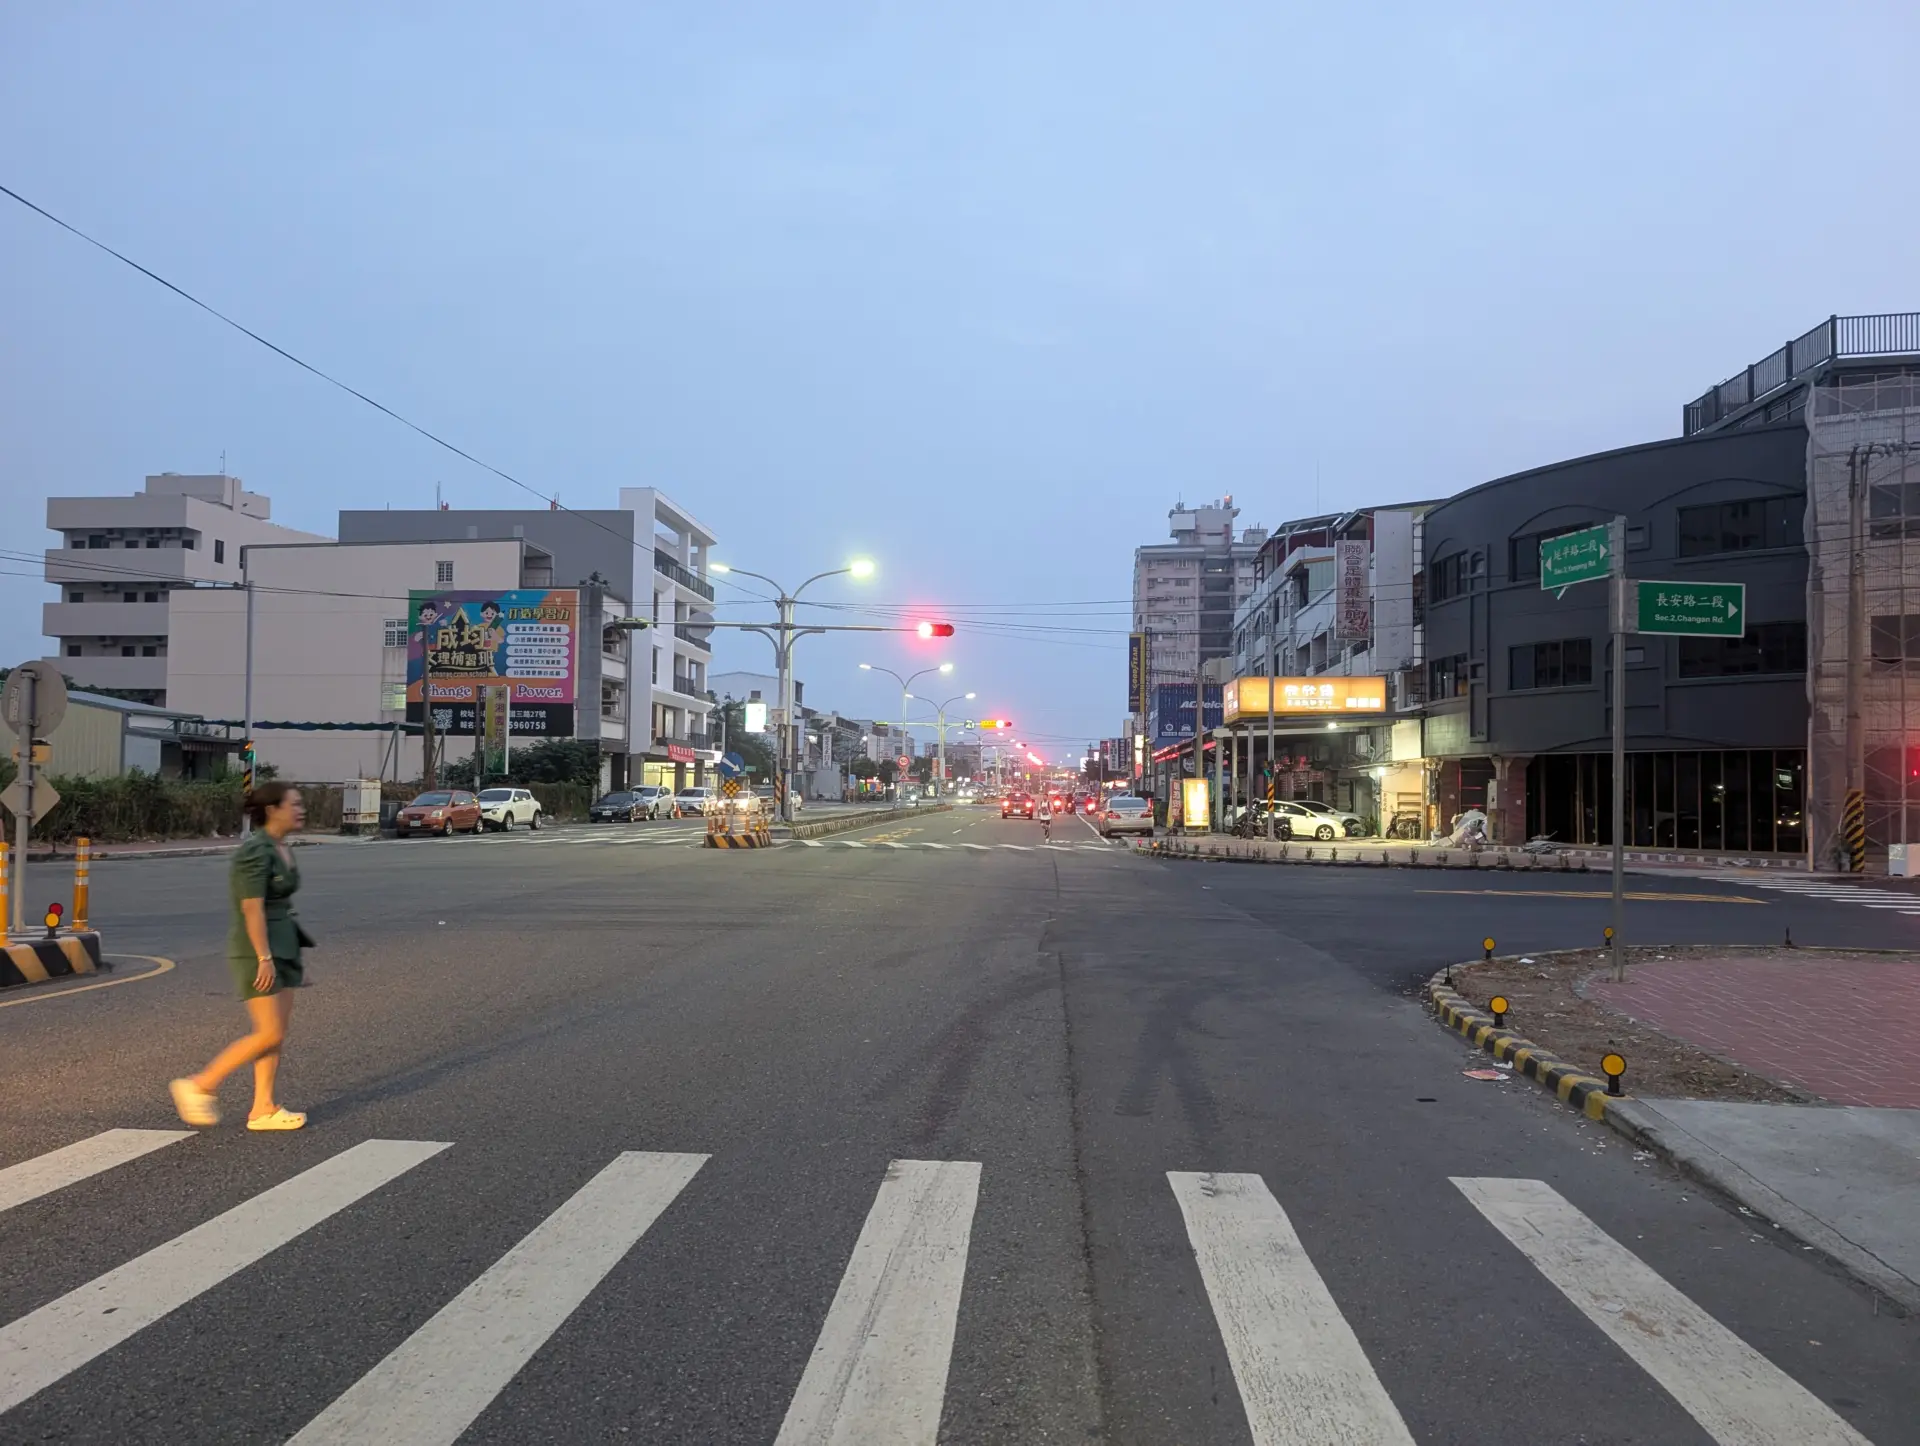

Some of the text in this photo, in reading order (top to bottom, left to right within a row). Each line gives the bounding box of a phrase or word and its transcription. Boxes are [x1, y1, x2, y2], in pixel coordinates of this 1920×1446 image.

[1656, 592, 1725, 608] 長安路二段
[508, 607, 570, 621] 打造學習力
[1712, 615, 1725, 623] Rd.
[437, 625, 486, 649] 成均
[428, 651, 495, 666] 文理補習班
[1131, 646, 1139, 693] GOODYEAR
[421, 684, 472, 699] Change
[516, 684, 563, 699] Power.
[1180, 700, 1224, 709] ACelc
